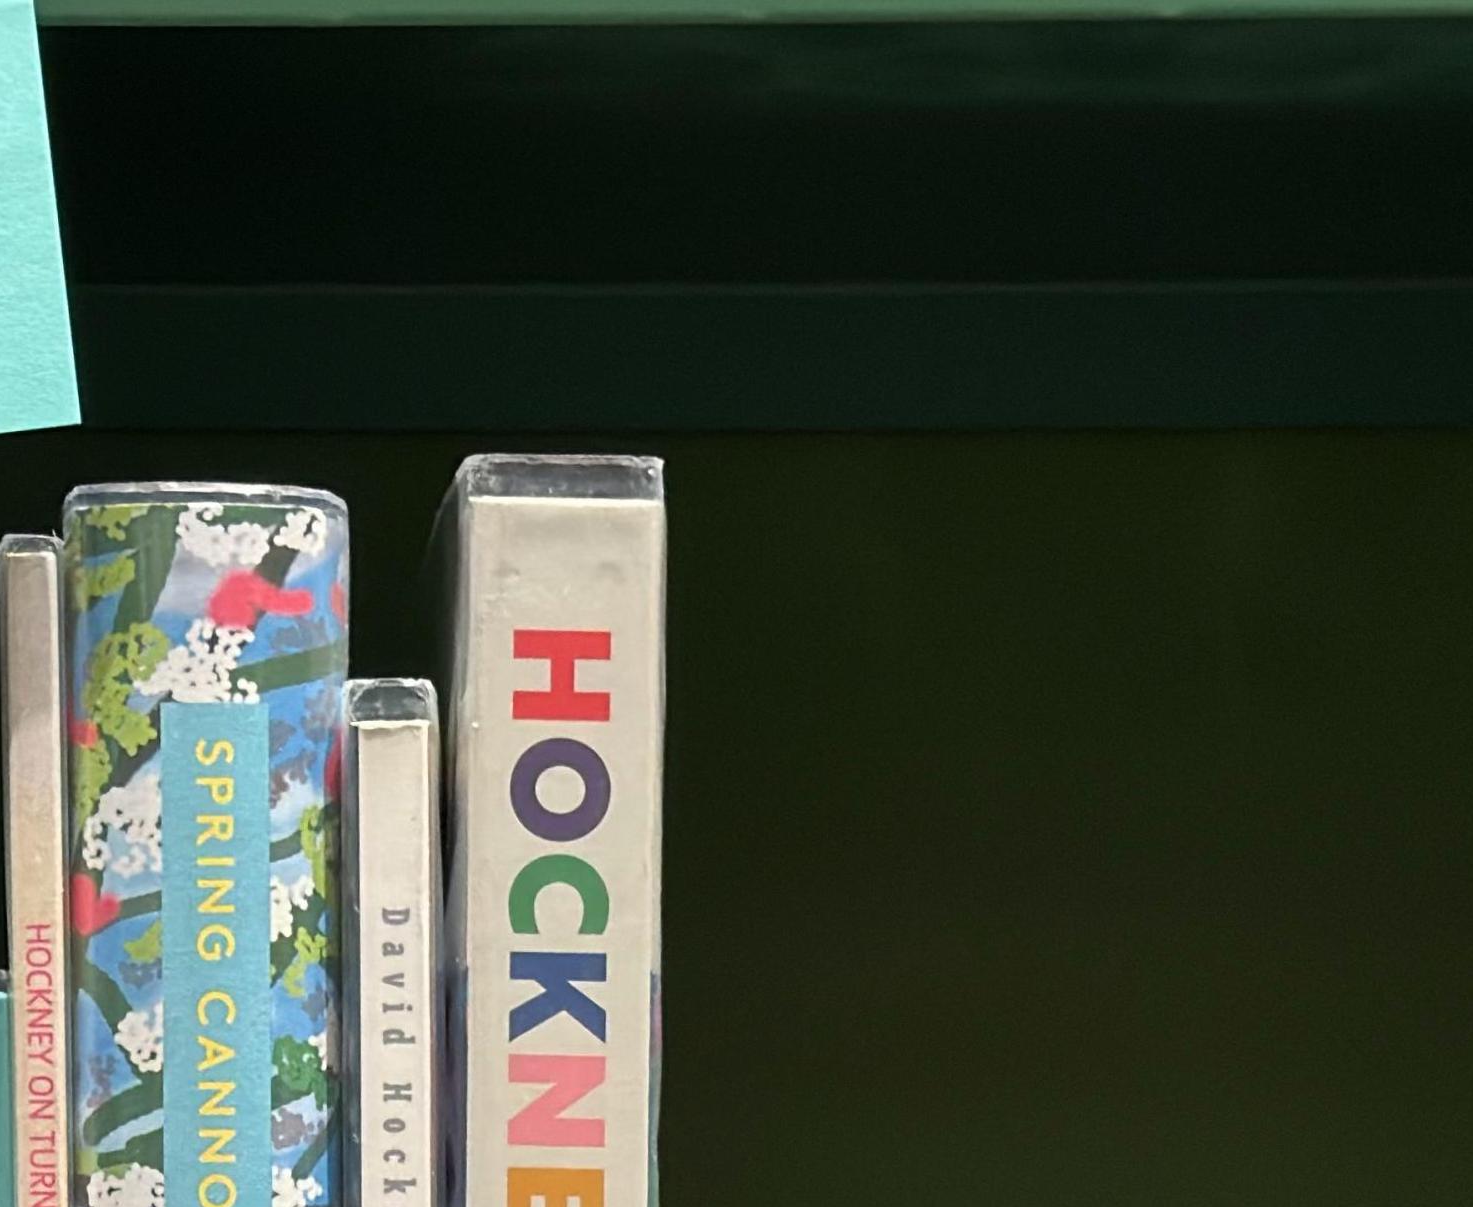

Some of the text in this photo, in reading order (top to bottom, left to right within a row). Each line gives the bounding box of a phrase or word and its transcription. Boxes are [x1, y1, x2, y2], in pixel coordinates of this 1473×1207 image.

[195, 738, 236, 962] SPRING
[25, 923, 54, 1063] HOCKNEY
[381, 907, 416, 1045] David
[28, 1074, 55, 1120] ON
